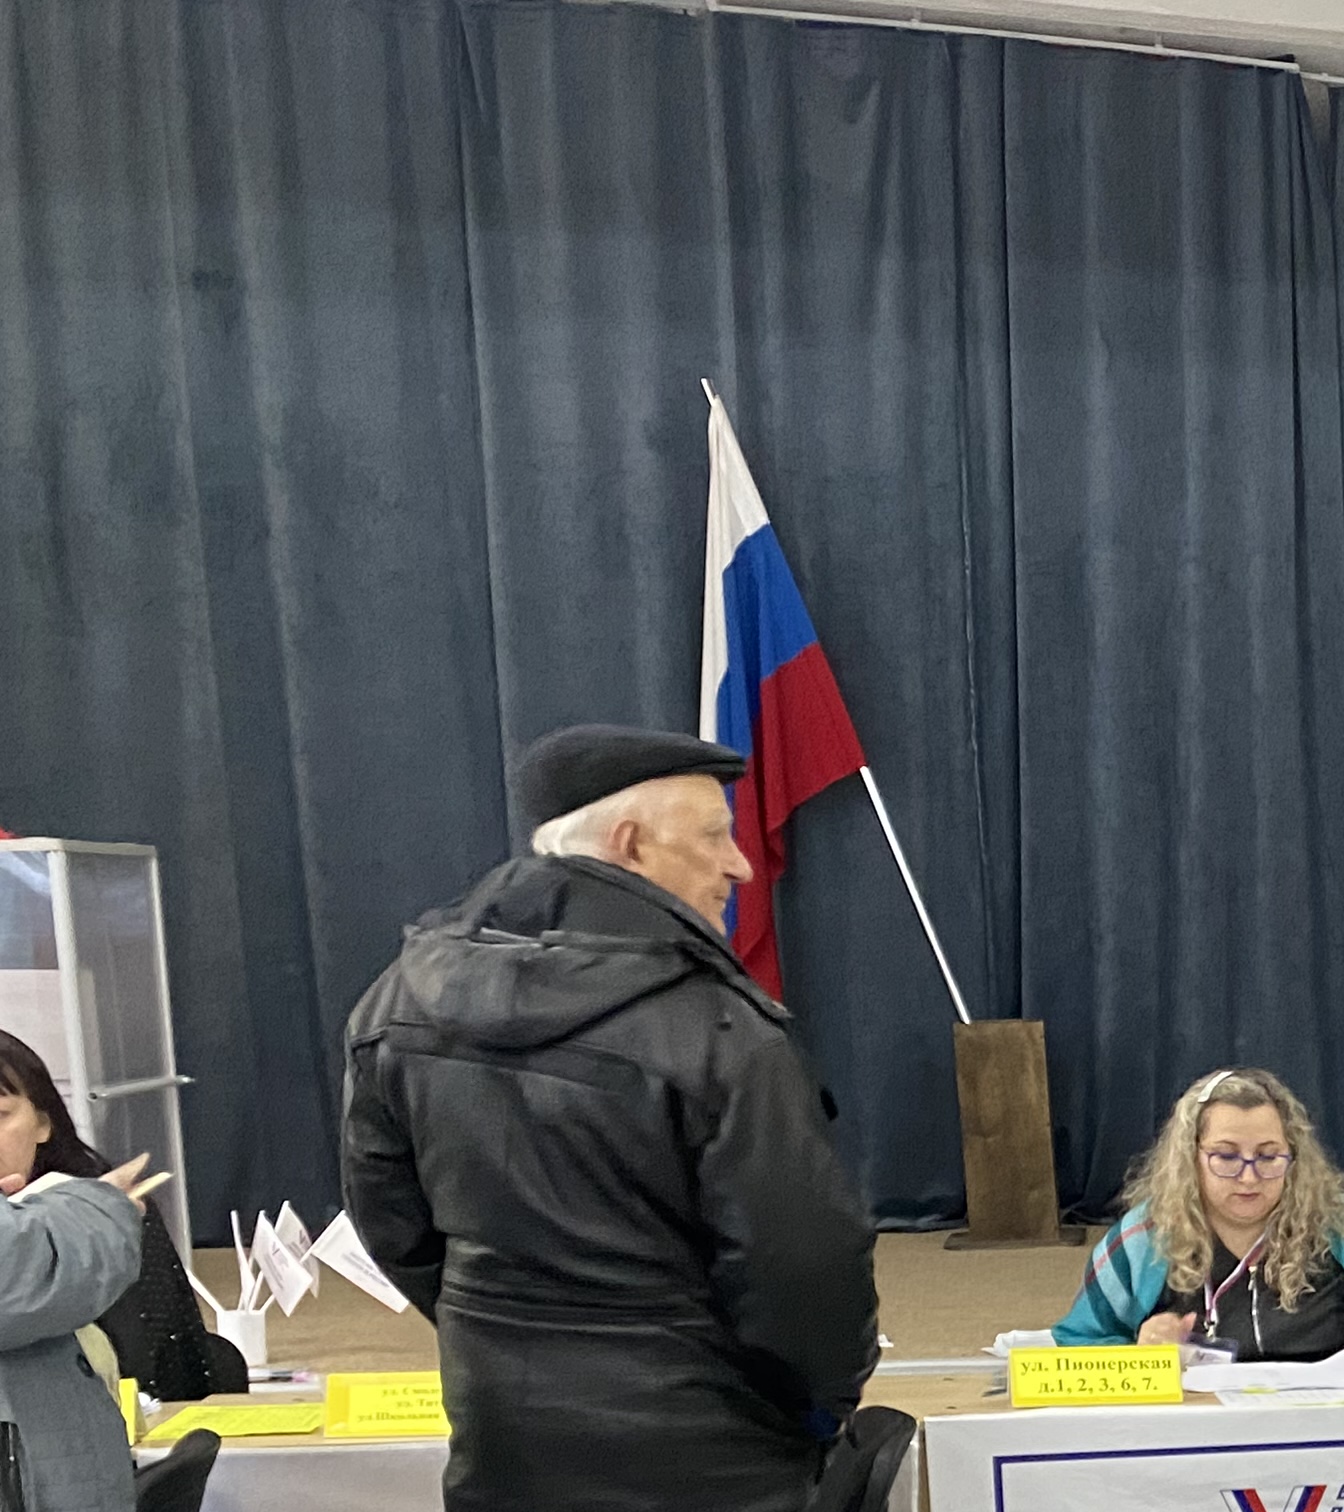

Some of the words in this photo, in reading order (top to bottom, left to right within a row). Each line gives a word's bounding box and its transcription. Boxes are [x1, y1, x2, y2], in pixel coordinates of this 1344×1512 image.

[1021, 1362, 1048, 1375] ул.
[1057, 1359, 1171, 1373] Пионерская
[1039, 1379, 1071, 1393] д.1,
[1078, 1378, 1093, 1393] 2,
[1099, 1378, 1115, 1392] 3,
[1121, 1379, 1136, 1391] 6,
[1142, 1377, 1157, 1390] 7.
